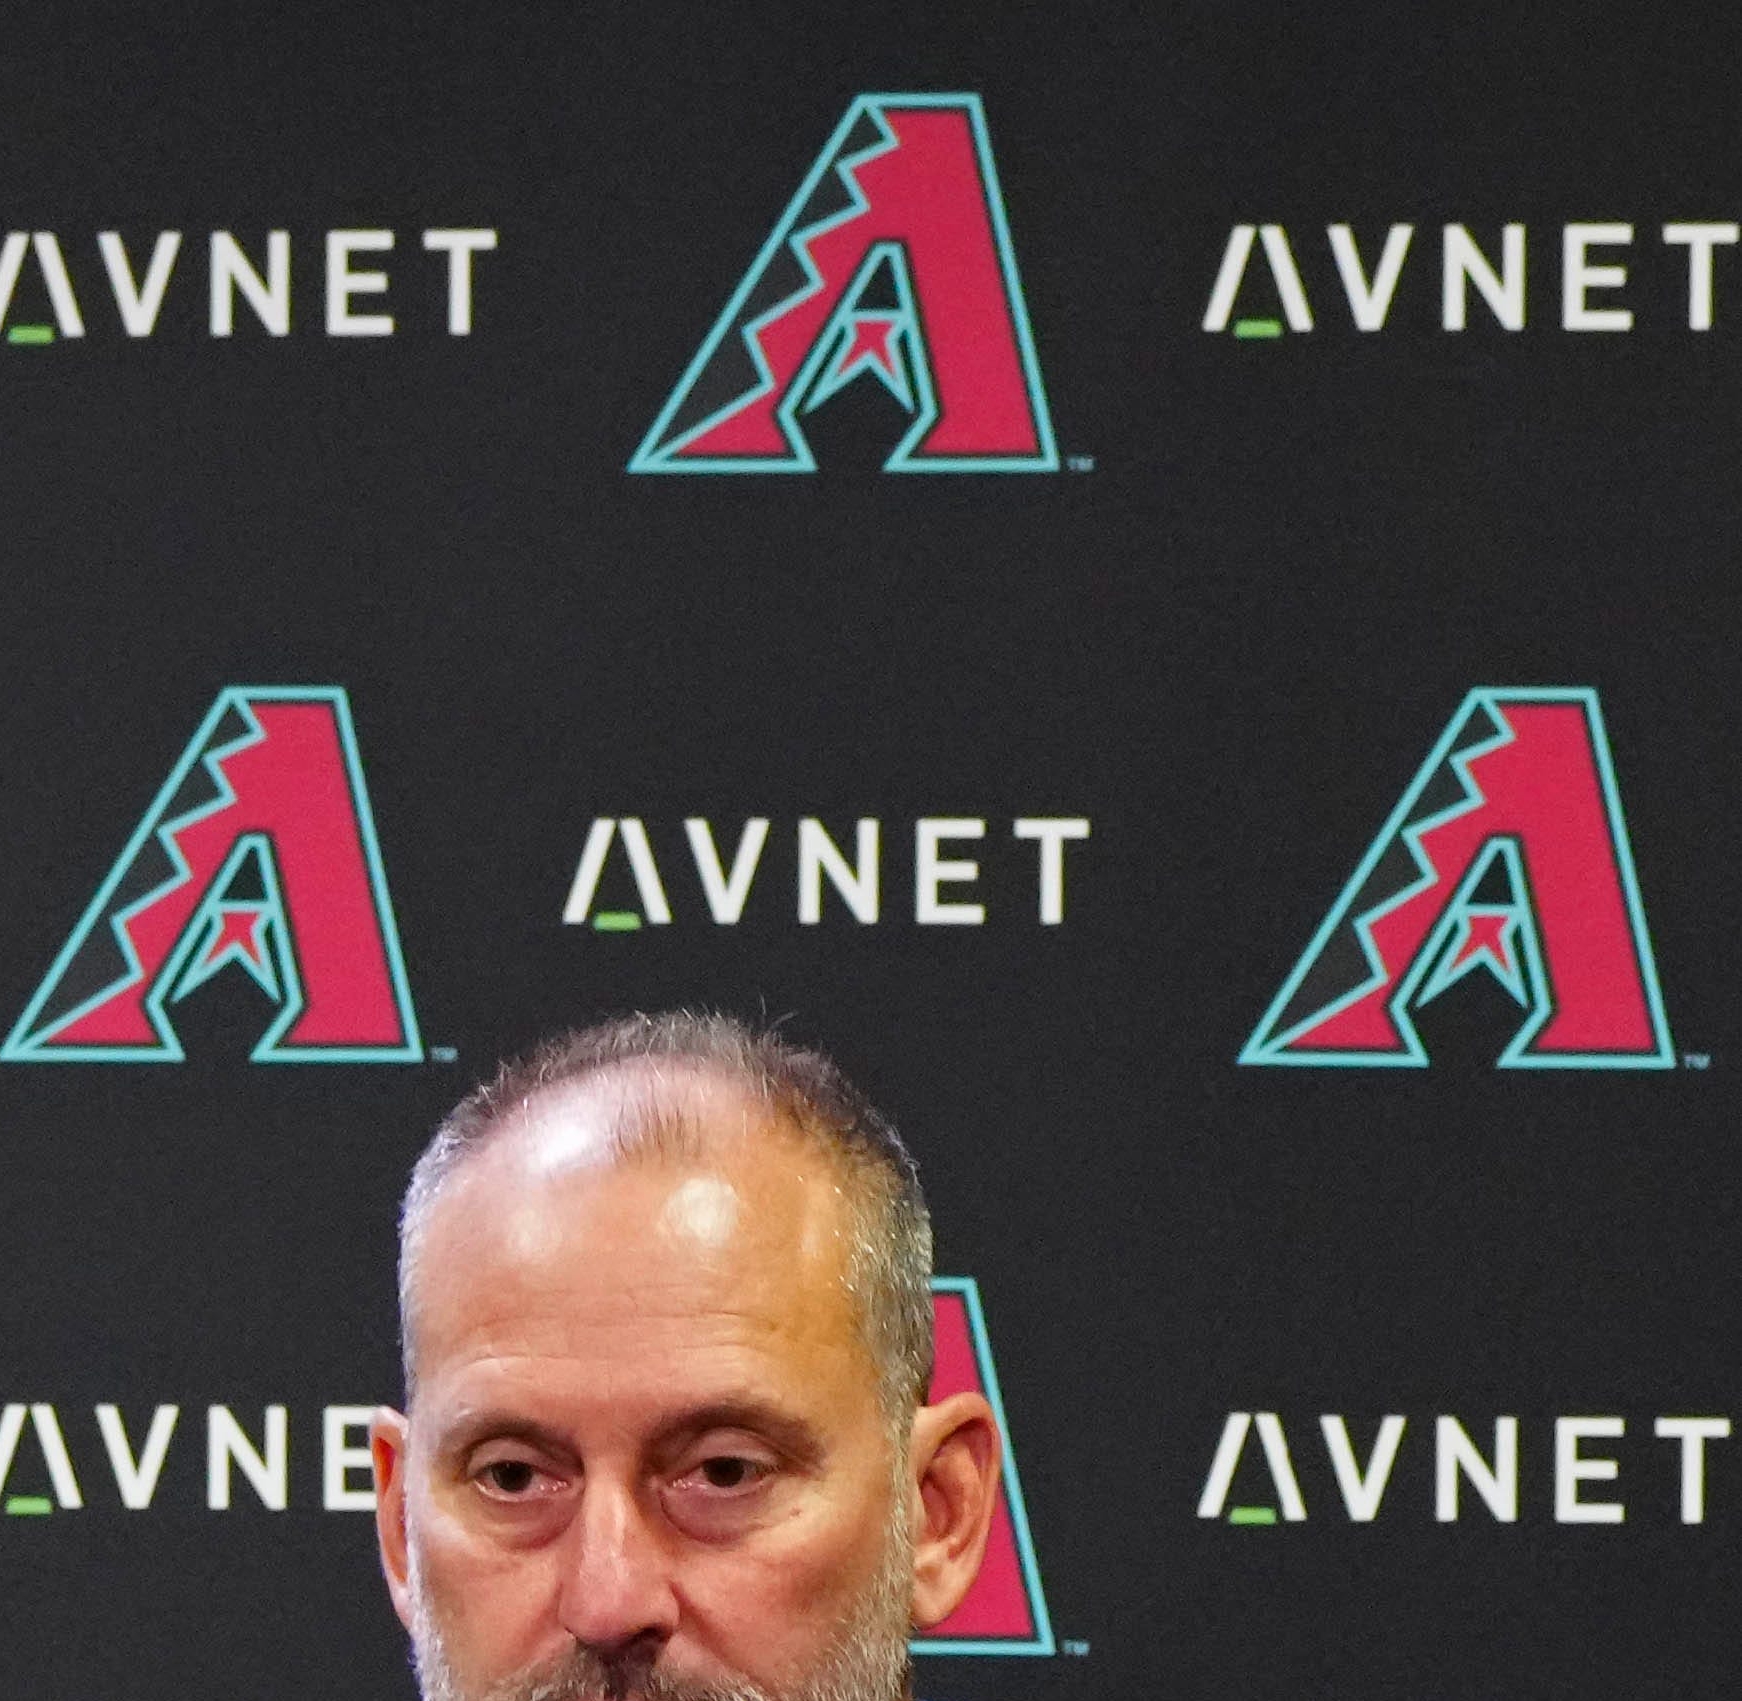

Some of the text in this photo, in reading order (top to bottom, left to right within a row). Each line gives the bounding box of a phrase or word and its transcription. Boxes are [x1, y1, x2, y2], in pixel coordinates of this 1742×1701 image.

[1203, 223, 1740, 339] AVNET
[563, 817, 1090, 932] AVNET
[1197, 1411, 1732, 1525] AVNET
